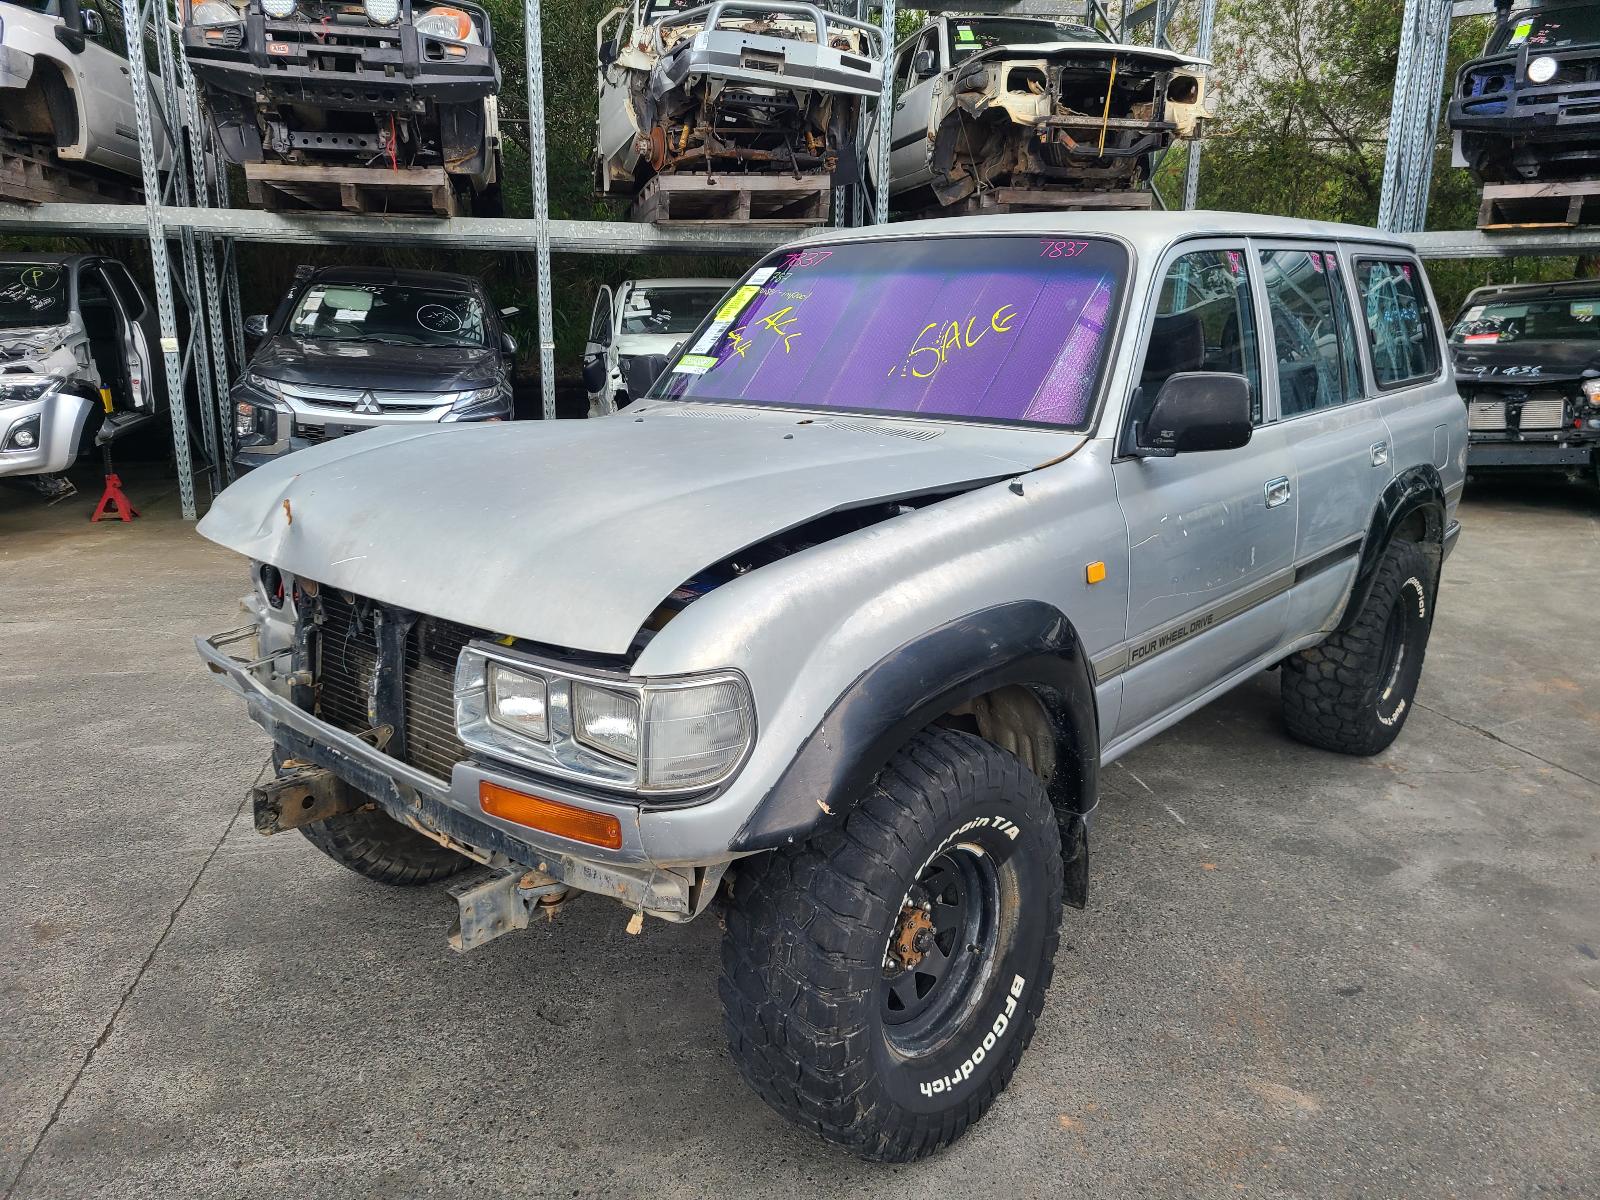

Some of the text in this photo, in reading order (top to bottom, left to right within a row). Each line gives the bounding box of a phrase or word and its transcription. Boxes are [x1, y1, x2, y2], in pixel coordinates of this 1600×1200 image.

[1039, 241, 1089, 258] 7837
[909, 303, 1018, 378] SALE
[1131, 613, 1214, 661] FOUR WHEEL DRIVE
[991, 815, 1020, 841] T/A
[919, 973, 1026, 1098] BFGoodrich
